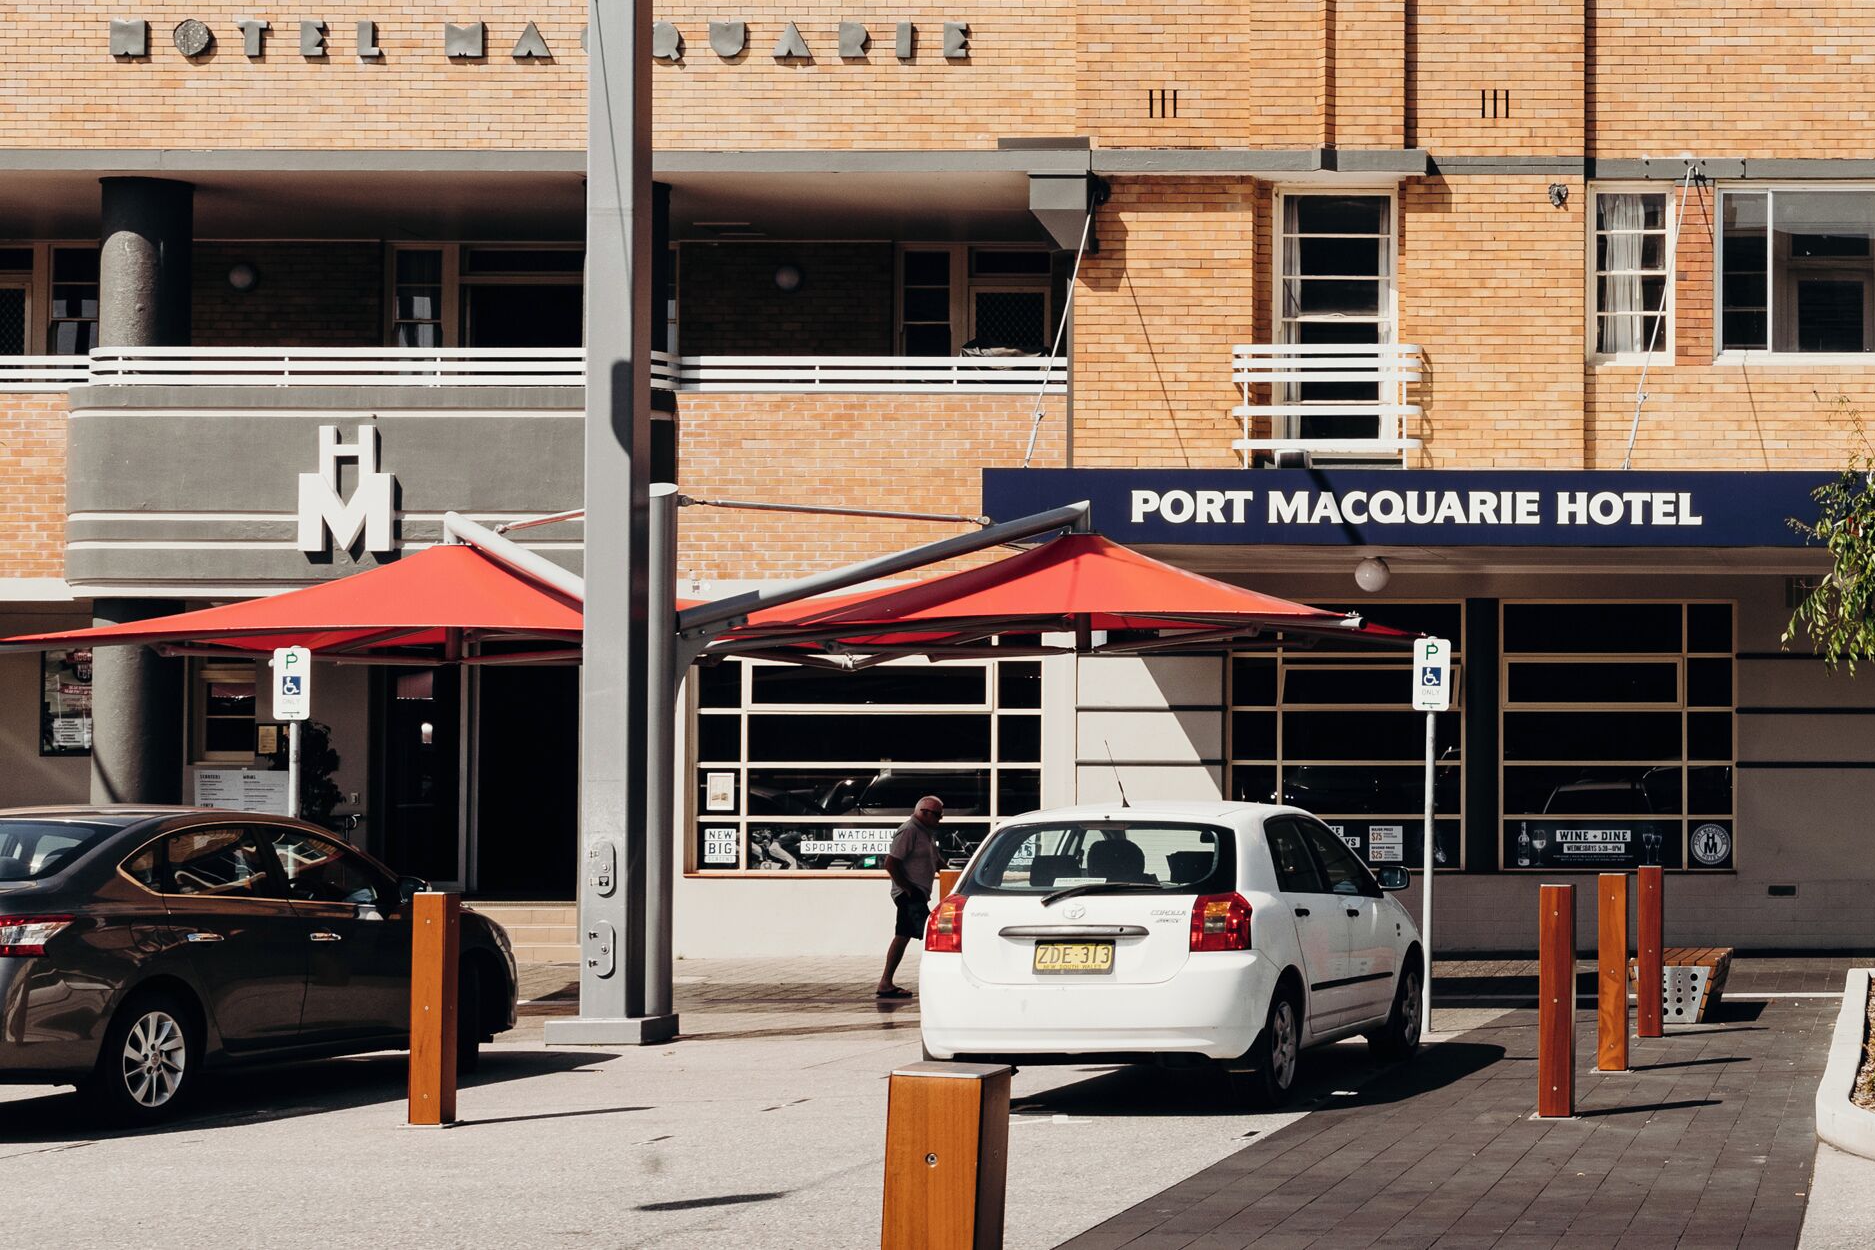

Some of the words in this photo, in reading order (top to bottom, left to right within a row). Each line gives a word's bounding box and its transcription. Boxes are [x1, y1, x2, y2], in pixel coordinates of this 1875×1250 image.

[109, 18, 381, 59] HOTEL
[444, 18, 969, 61] MAQUARIE
[1130, 489, 1254, 524] PORT
[1268, 490, 1541, 525] MACQUARIE
[1556, 491, 1703, 526] HOTEL
[1426, 644, 1439, 661] P
[285, 653, 299, 669] P
[708, 830, 733, 840] NEW
[837, 830, 875, 840] WATCH
[879, 830, 897, 840] LIV
[1560, 831, 1589, 841] WINE
[1601, 831, 1628, 841] DINE
[708, 843, 733, 854] BIG
[805, 843, 847, 852] SPORTS
[851, 844, 858, 852] &
[862, 843, 891, 852] RACI
